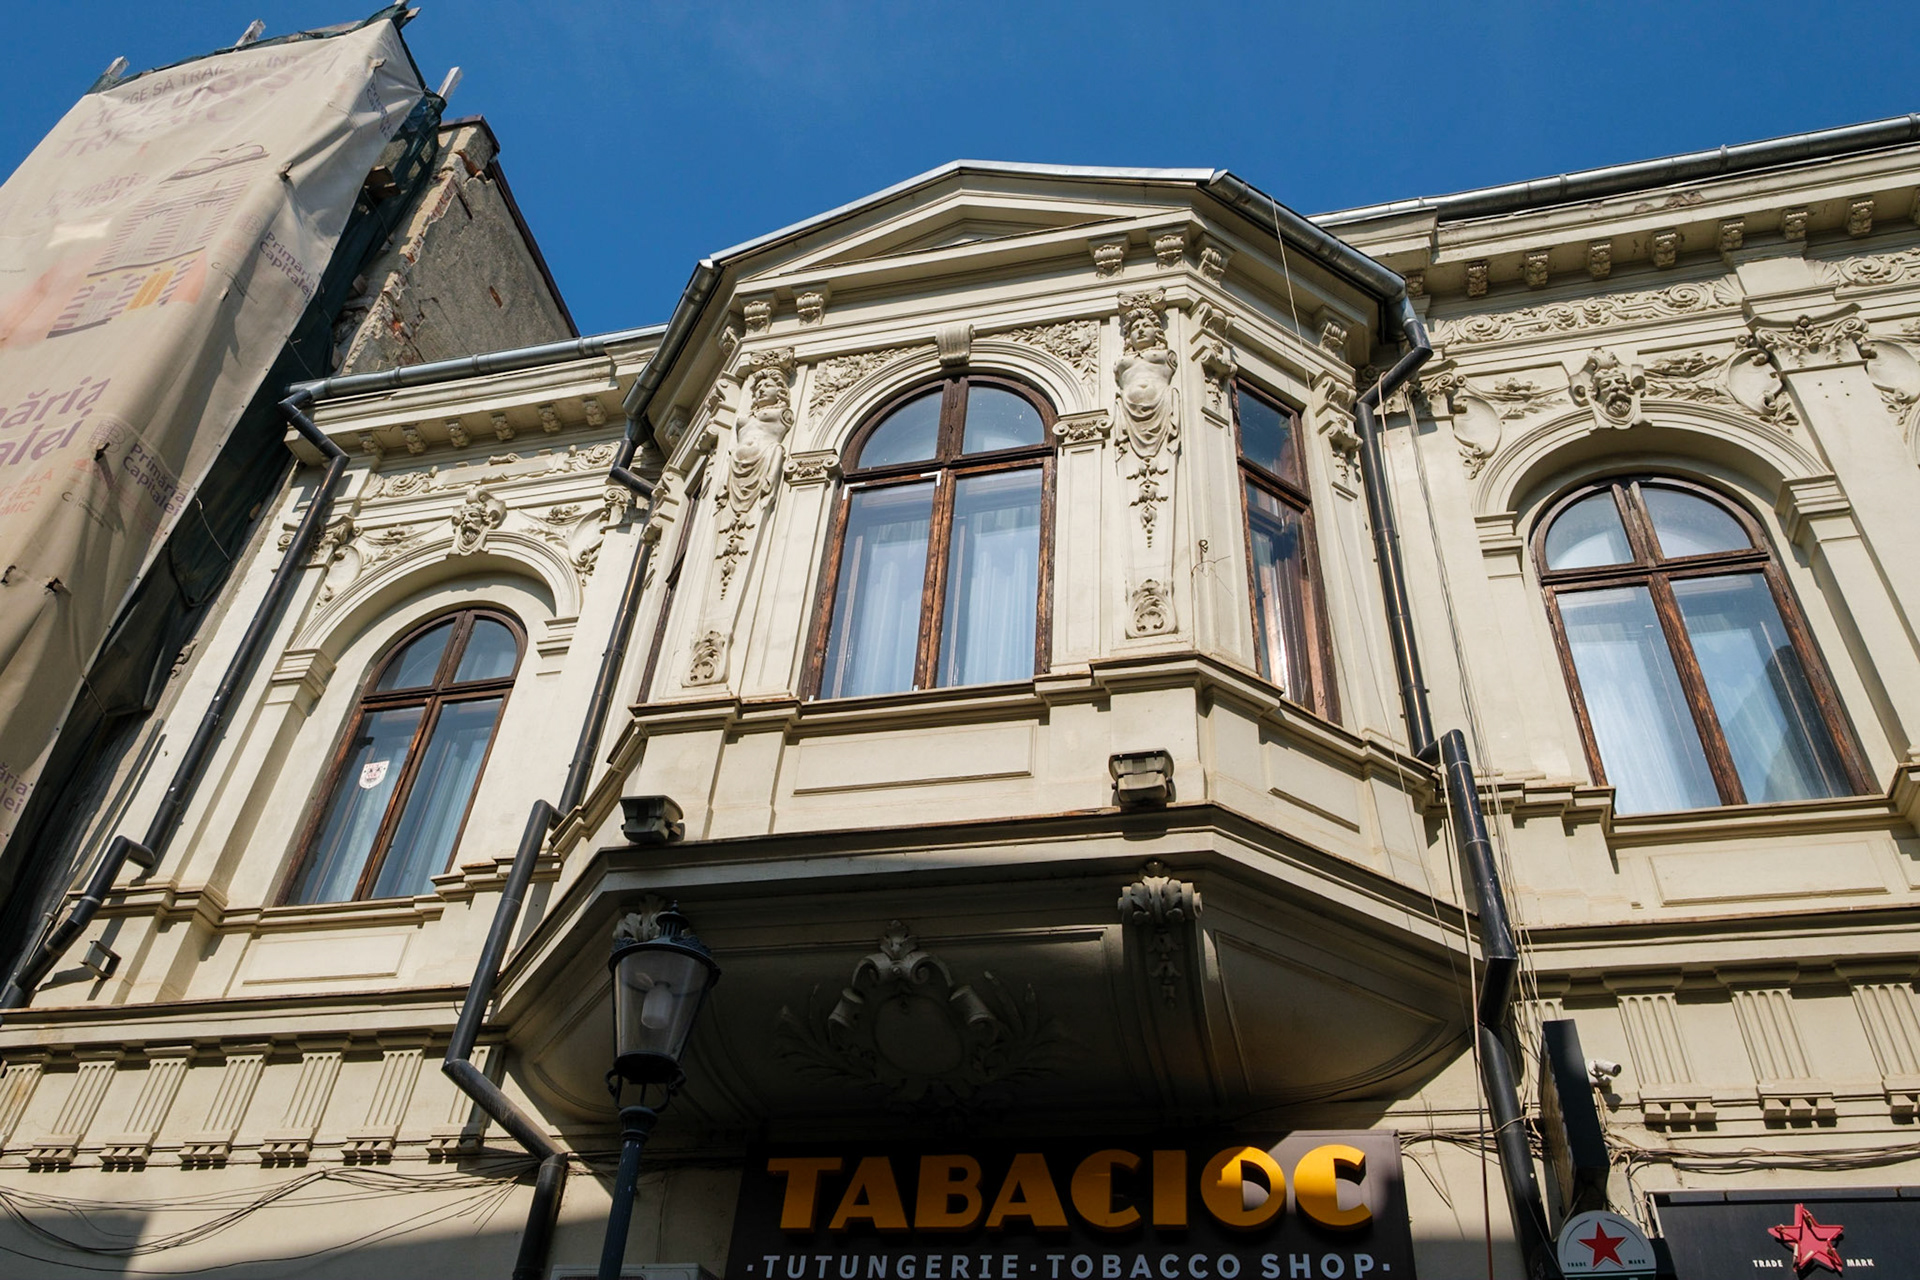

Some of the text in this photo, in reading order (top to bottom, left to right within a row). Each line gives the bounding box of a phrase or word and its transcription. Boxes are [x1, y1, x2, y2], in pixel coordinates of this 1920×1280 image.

[260, 241, 314, 300] Capitalei
[123, 455, 183, 517] Capitalei
[130, 443, 187, 504] Primăria
[767, 1144, 1374, 1234] TABACIOC
[762, 1253, 1375, 1279] TUTUNGERIE TOBACCO SHOP
[1752, 1258, 1875, 1268] TRADE MARK
